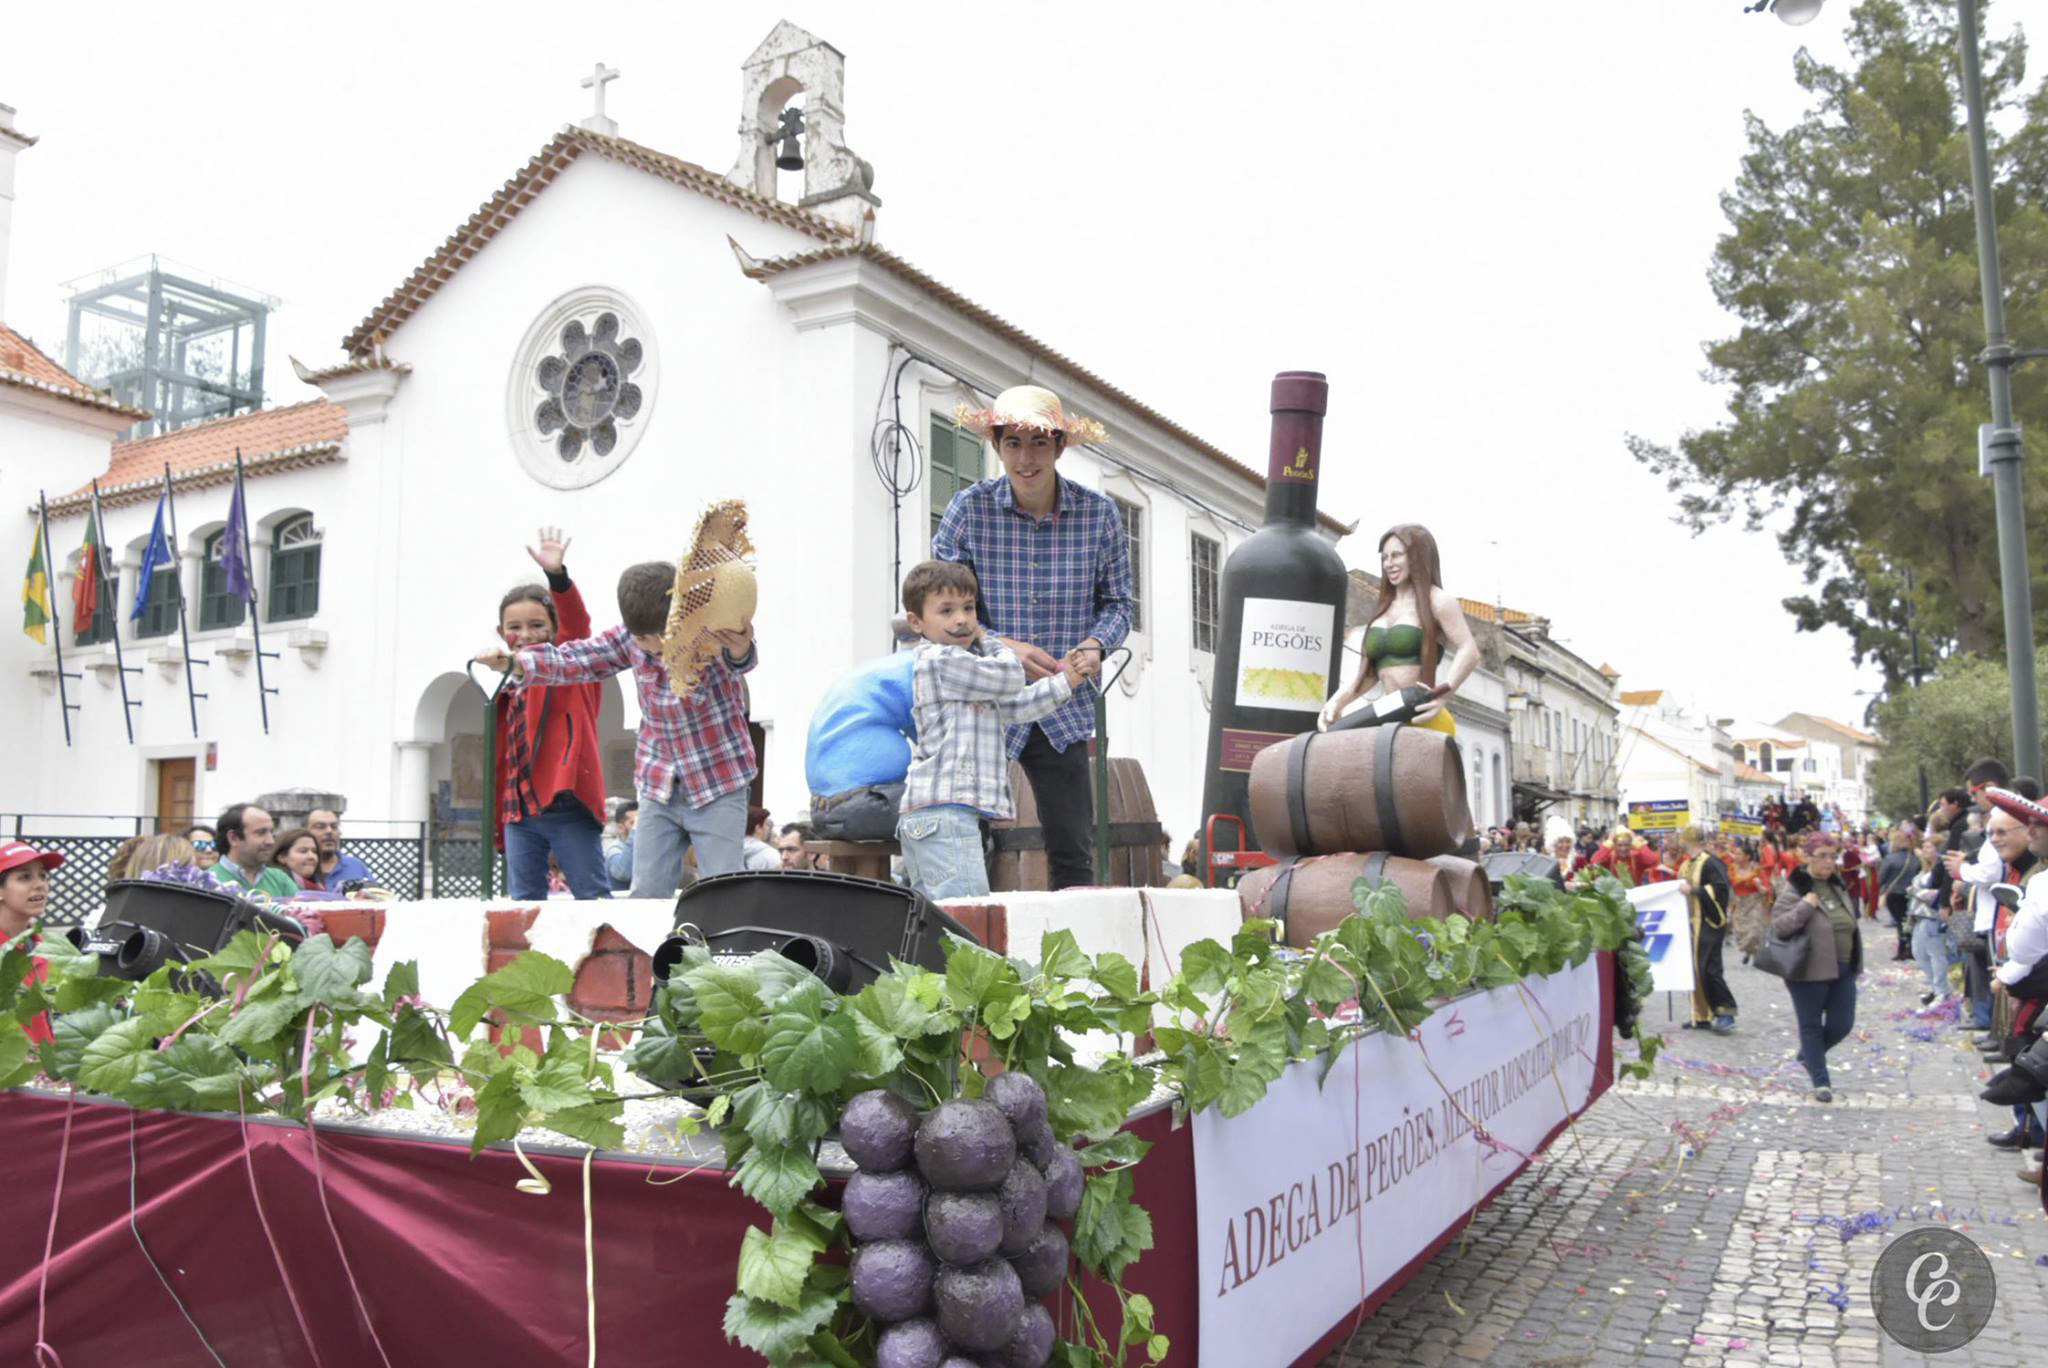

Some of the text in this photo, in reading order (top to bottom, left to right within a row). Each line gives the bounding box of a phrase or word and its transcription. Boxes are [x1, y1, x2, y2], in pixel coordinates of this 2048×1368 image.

[1217, 1174, 1322, 1298] ADEGA
[1328, 1152, 1361, 1228] DE
[1442, 1069, 1501, 1149] MELHOR
